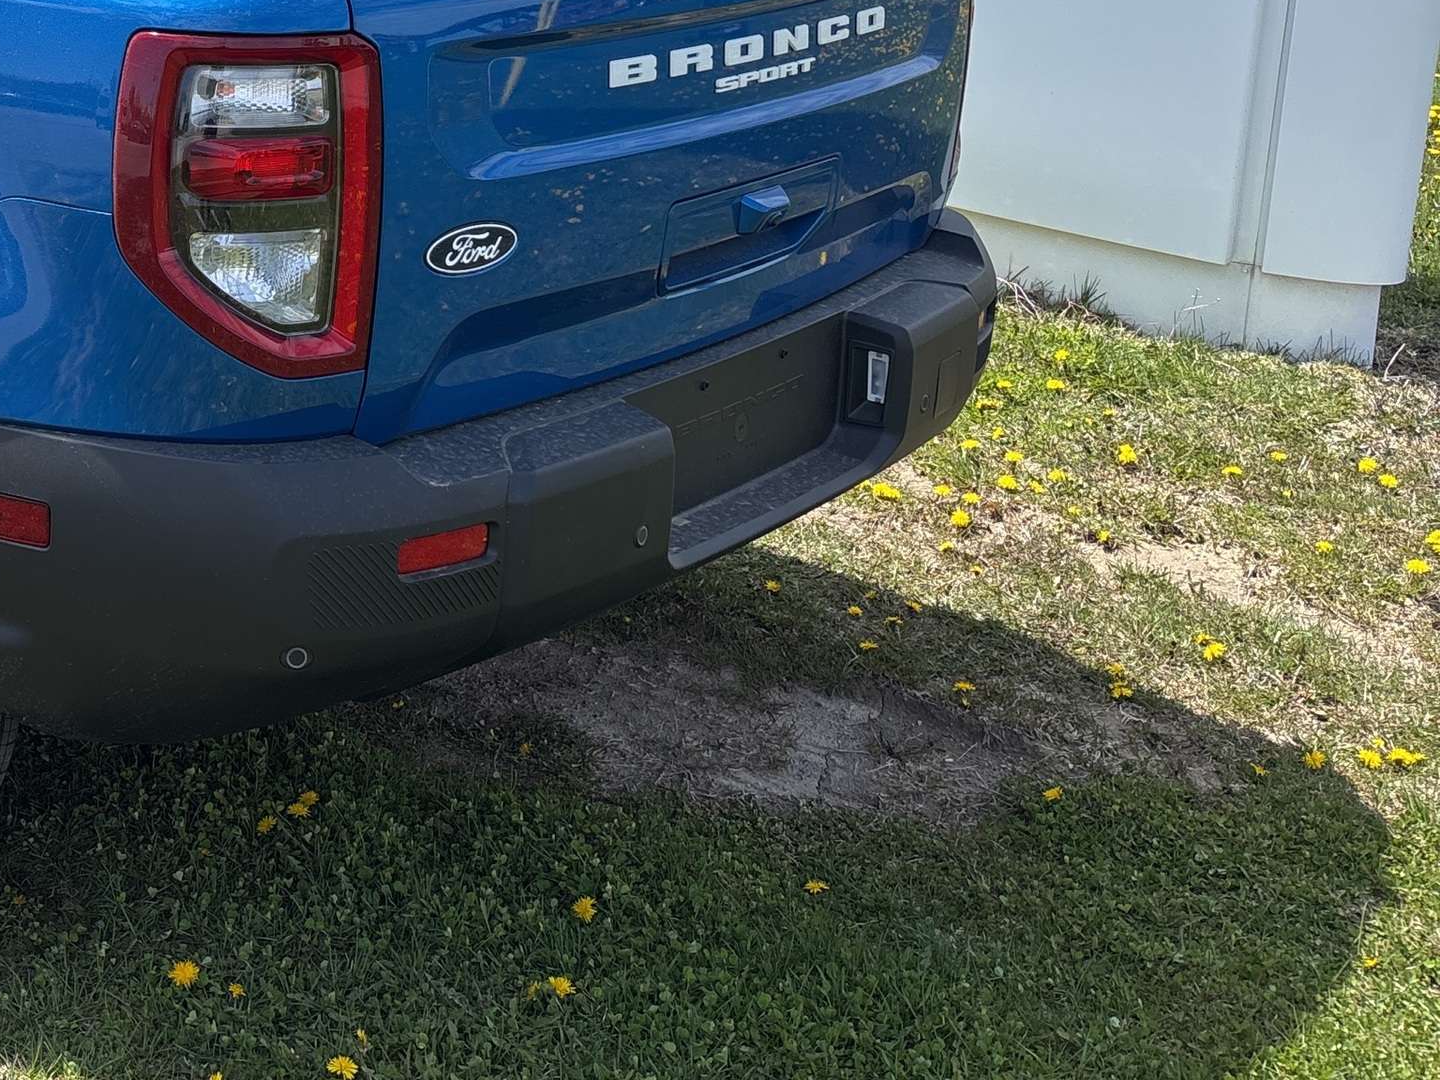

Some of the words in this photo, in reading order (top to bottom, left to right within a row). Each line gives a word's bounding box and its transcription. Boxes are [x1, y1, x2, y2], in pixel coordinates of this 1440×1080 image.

[609, 6, 886, 89] BRONCO
[714, 56, 817, 93] SPORT
[445, 231, 503, 267] Ford
